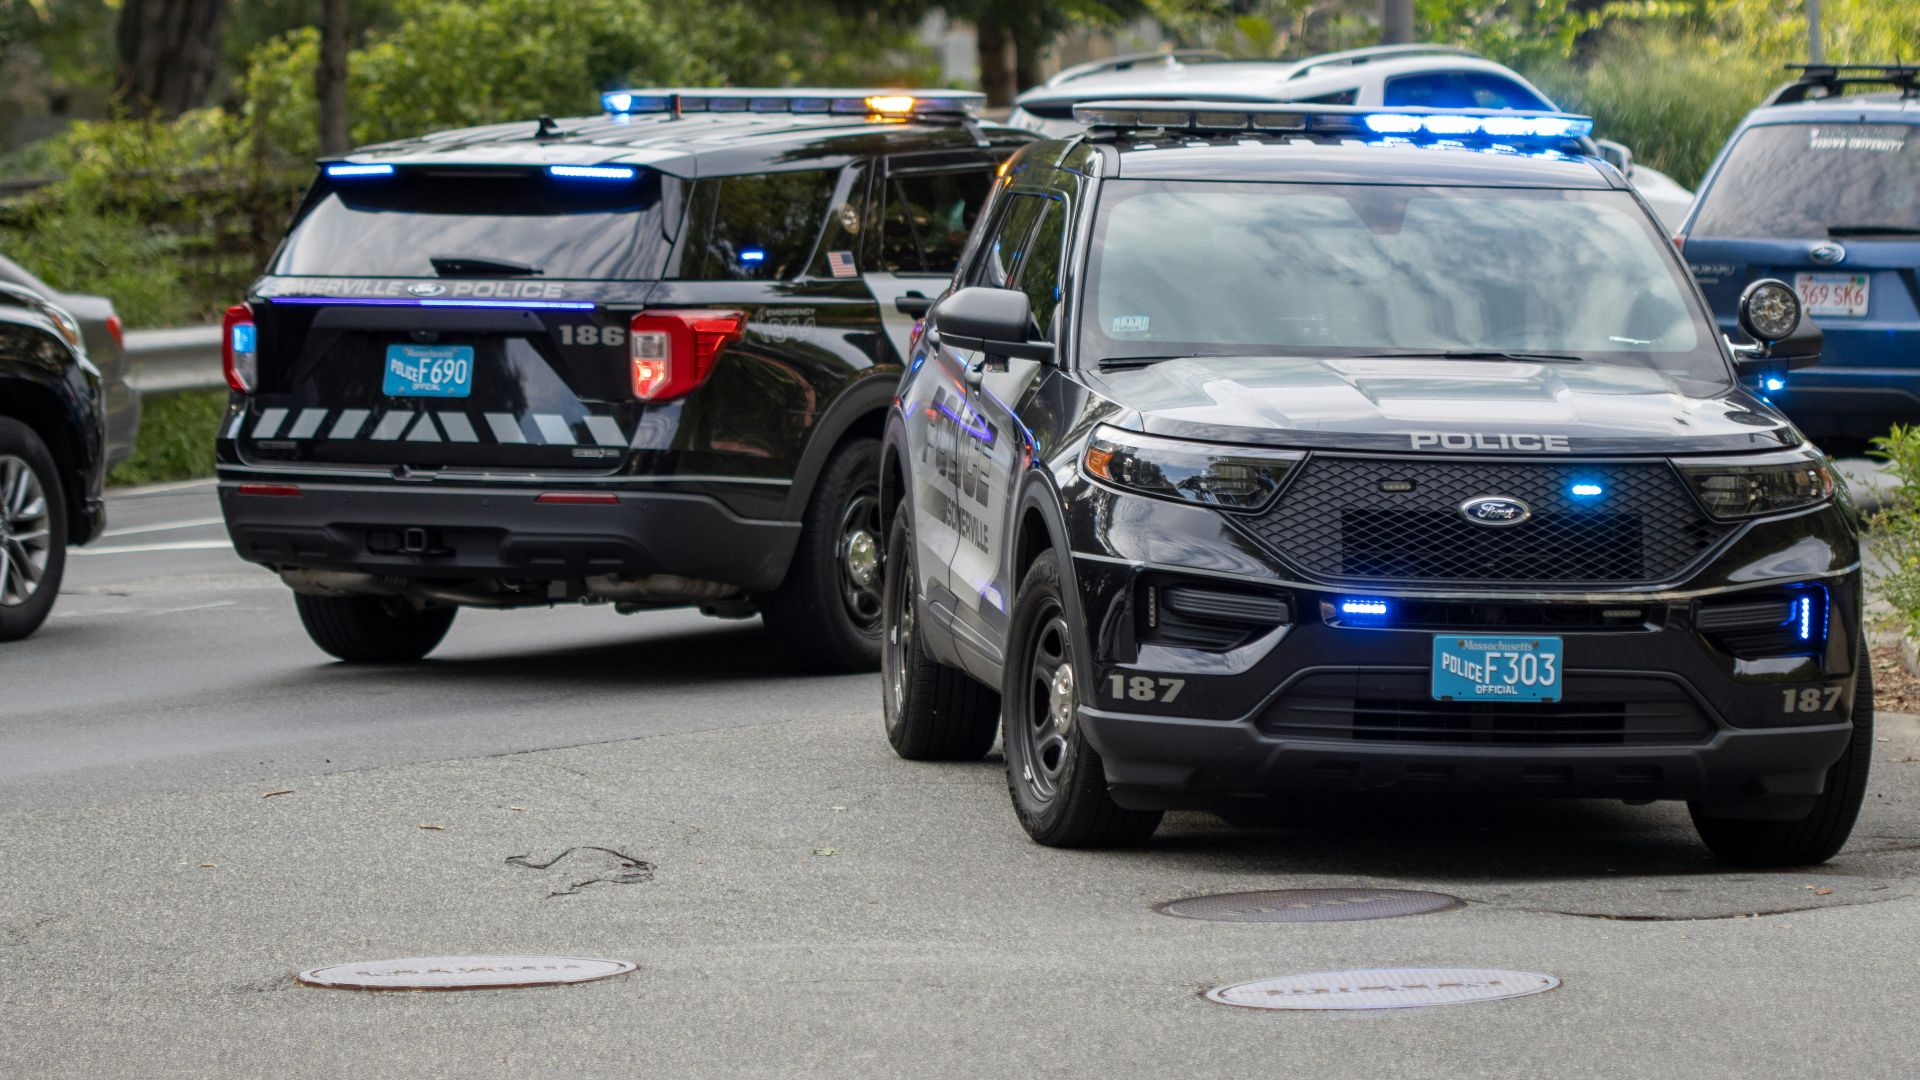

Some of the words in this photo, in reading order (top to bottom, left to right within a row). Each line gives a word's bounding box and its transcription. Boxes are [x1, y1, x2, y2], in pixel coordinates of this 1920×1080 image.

[451, 281, 565, 298] POLICE
[1800, 284, 1829, 305] 369
[1834, 285, 1865, 306] SK6
[766, 308, 816, 317] EMERGENCY
[559, 325, 625, 346] 186
[391, 358, 419, 383] POLICE
[419, 359, 467, 385] F690
[922, 385, 999, 509] POLICE
[1410, 431, 1571, 452] POLICE
[1477, 503, 1516, 519] Ford
[1463, 640, 1533, 651] Massachusetts
[1442, 652, 1482, 684] POLICE
[1485, 652, 1556, 686] F303
[1108, 674, 1186, 703] 187
[1475, 685, 1518, 695] OFFICIAL
[1782, 686, 1843, 713] 187
